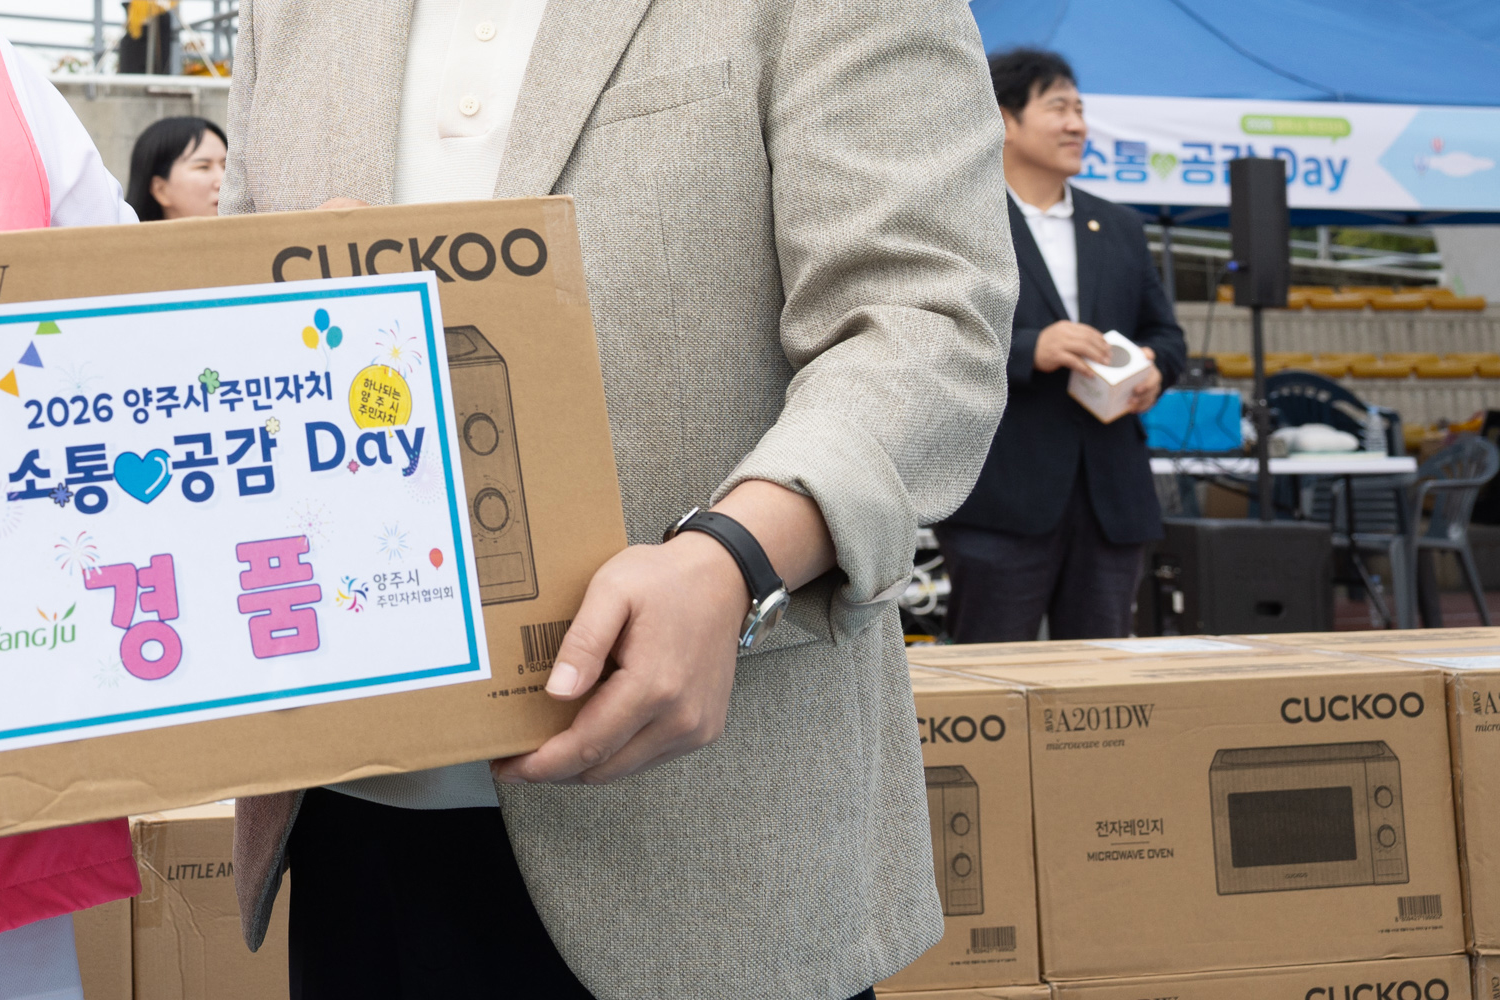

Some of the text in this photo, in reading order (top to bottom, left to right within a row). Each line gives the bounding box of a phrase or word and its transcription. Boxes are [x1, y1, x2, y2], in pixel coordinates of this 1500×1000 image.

[272, 228, 548, 284] CUCKOO
[24, 370, 333, 430] 2026 양주시 주민자치
[363, 378, 402, 401] 하나되는
[358, 403, 397, 426] 주민자치
[7, 419, 427, 515] 소통 공감 Day
[372, 569, 421, 592] 양주시
[376, 586, 454, 608] 주민자치협의회
[1055, 703, 1156, 733] A201DW
[1281, 691, 1425, 724] CUCKOO
[1095, 818, 1164, 838] 전자레인지
[1087, 847, 1174, 862] MICROWAVE OVEN
[167, 863, 215, 881] LITTLE
